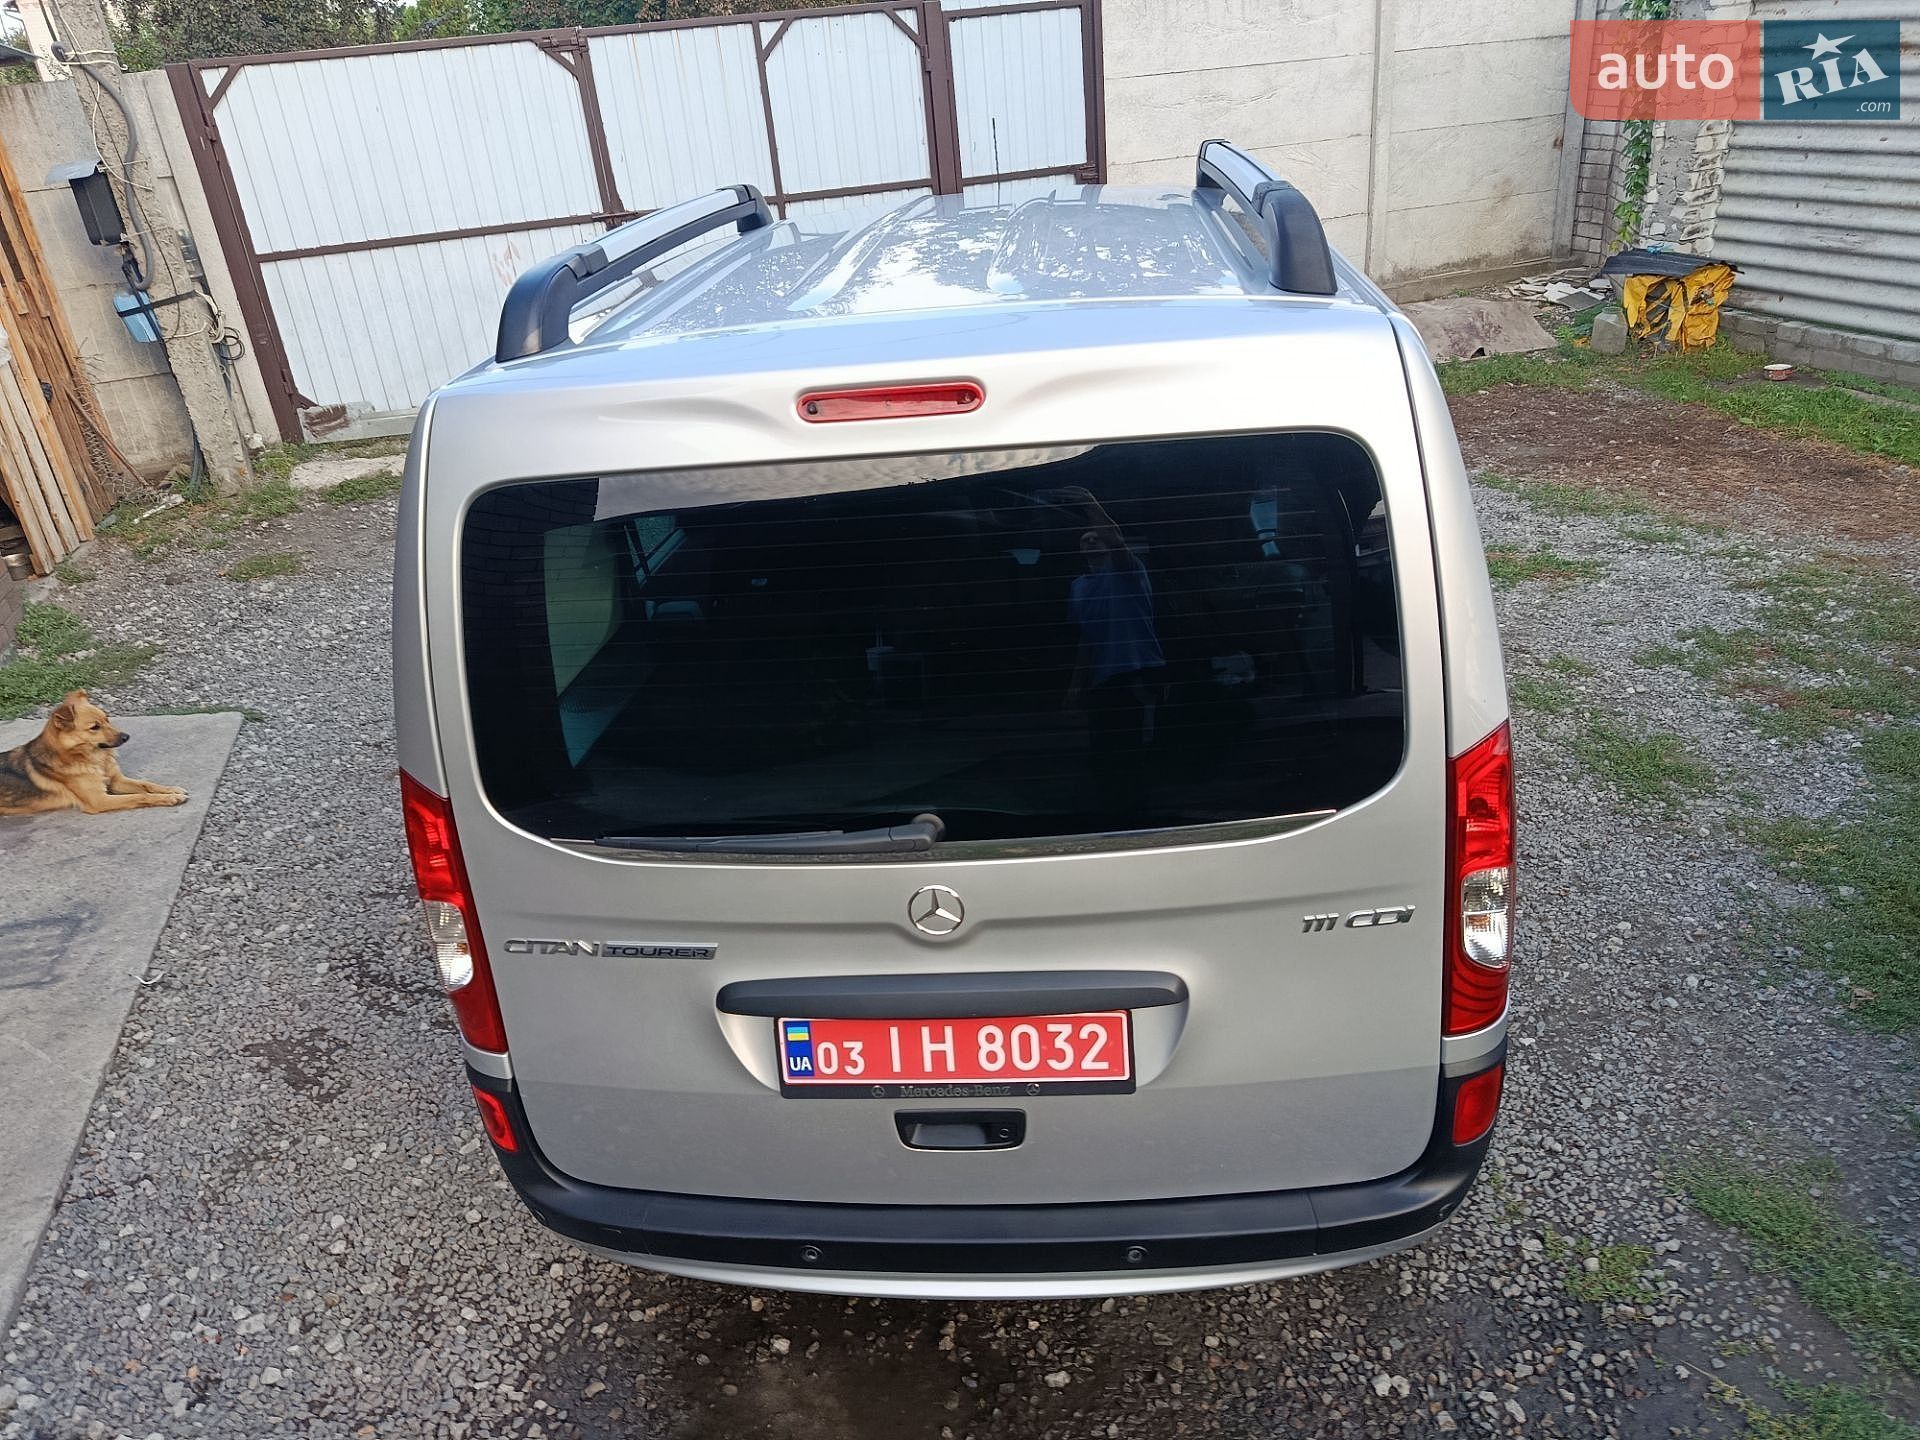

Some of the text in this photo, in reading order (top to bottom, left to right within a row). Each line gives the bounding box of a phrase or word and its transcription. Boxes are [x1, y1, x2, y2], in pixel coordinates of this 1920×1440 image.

[503, 938, 709, 958] CITAN TOURER
[816, 1041, 866, 1076] 03
[976, 1023, 1109, 1072] 8032
[789, 1056, 812, 1072] UA
[900, 1084, 1011, 1098] Mercedes-Benz
